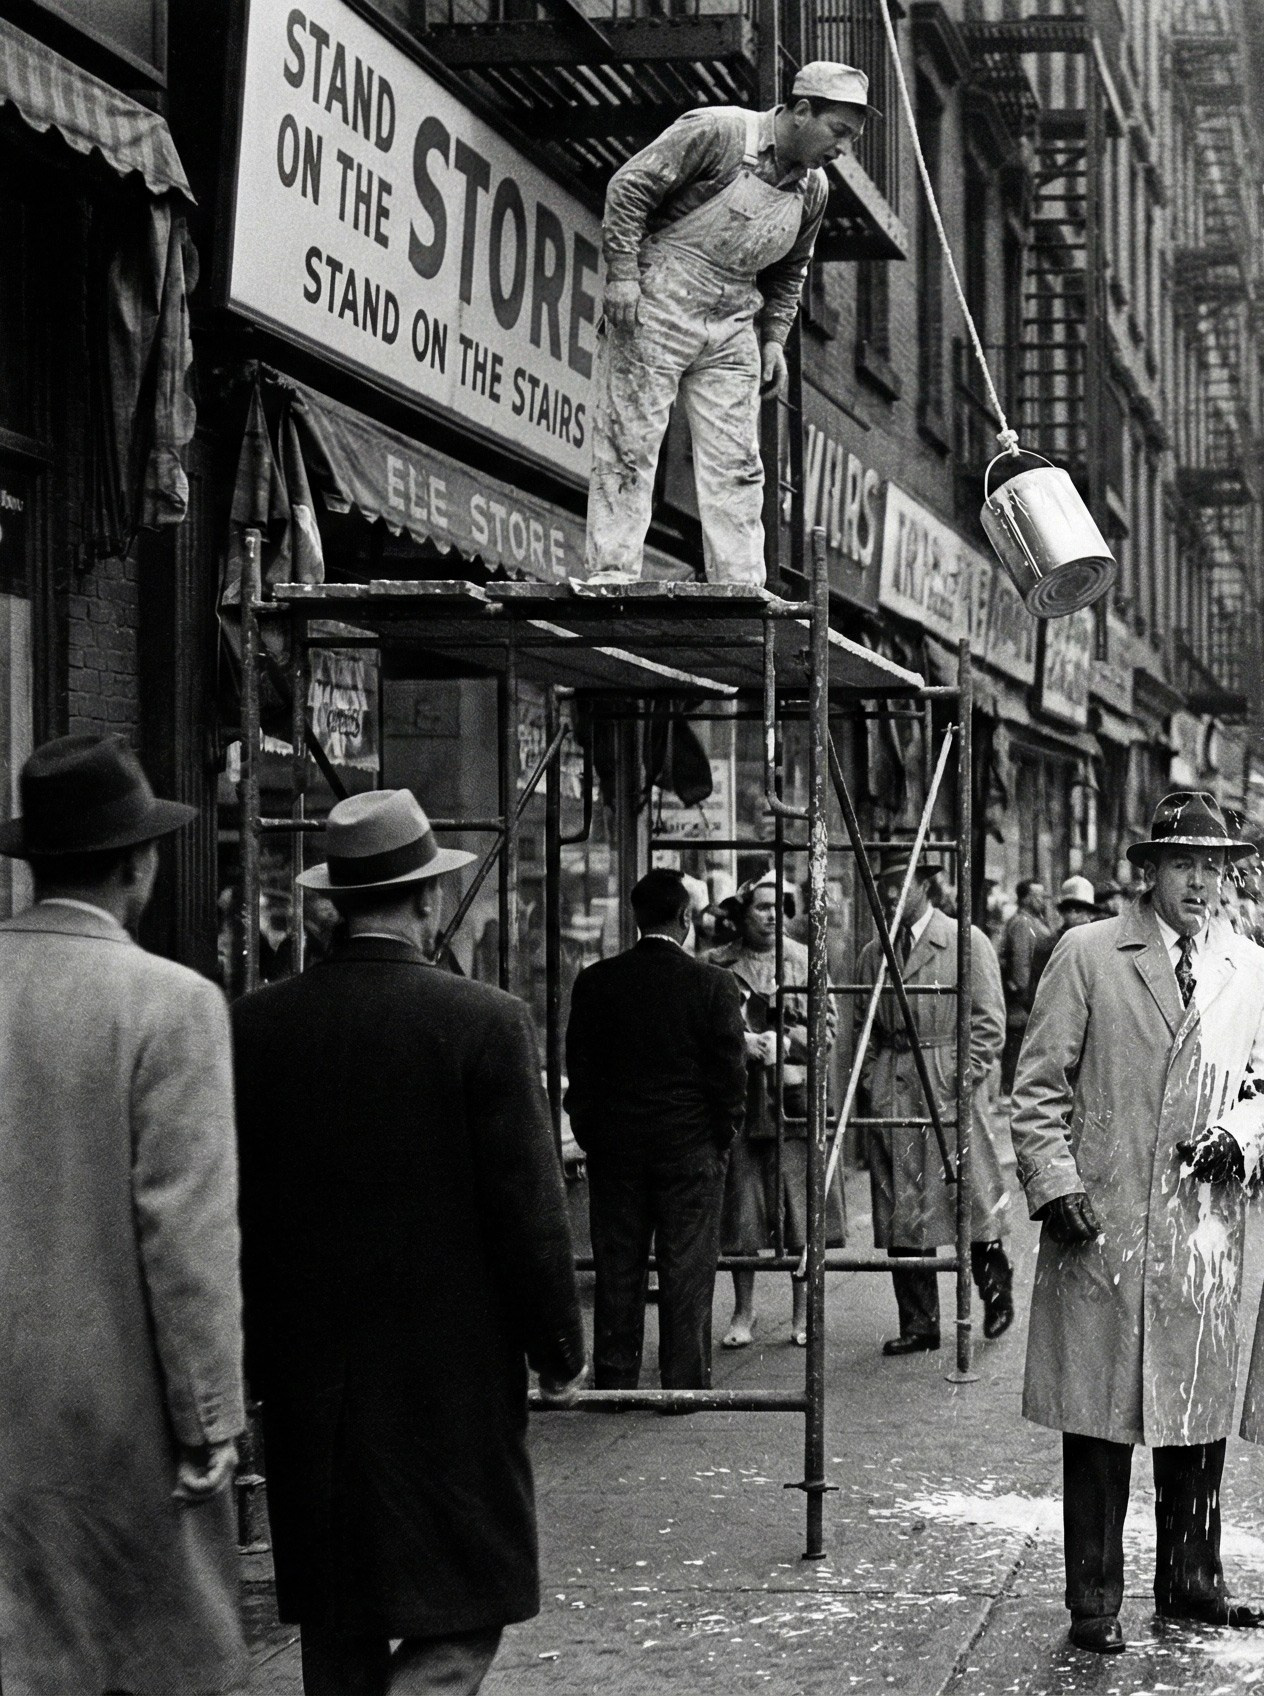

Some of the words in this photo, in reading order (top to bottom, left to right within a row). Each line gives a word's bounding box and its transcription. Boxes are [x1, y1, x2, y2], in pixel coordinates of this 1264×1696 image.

[283, 8, 396, 153] STAND
[277, 113, 323, 206] ON
[336, 148, 392, 249] THE
[407, 116, 599, 380] STORE
[303, 246, 399, 345] STAND
[412, 309, 447, 374] ON
[459, 333, 503, 403] THE
[512, 367, 585, 448] STAIRS
[470, 493, 566, 577] STORE
